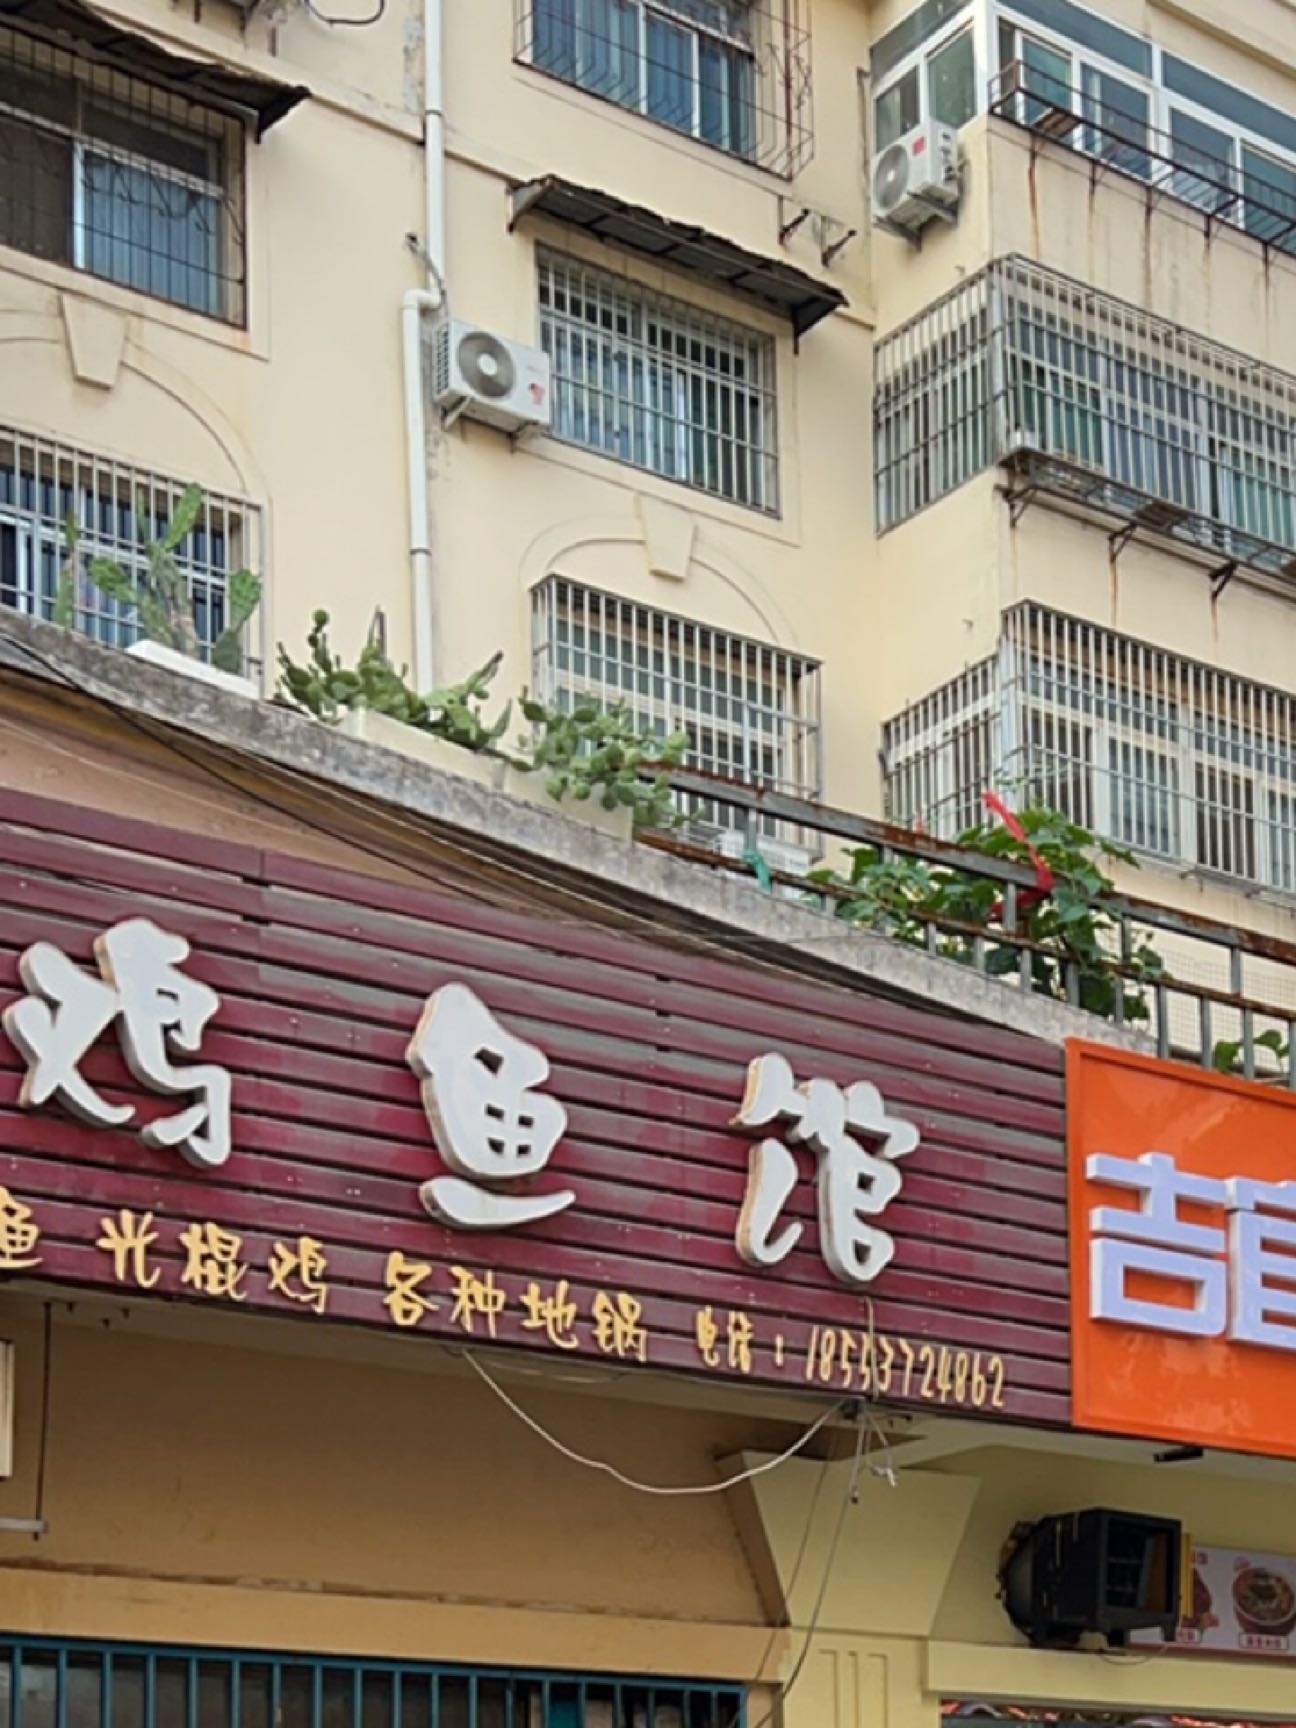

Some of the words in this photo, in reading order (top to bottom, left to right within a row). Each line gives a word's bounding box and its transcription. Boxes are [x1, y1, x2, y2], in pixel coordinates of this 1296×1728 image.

[97, 1208, 330, 1314] 光棍鸡
[382, 1252, 648, 1362] 各种地锅
